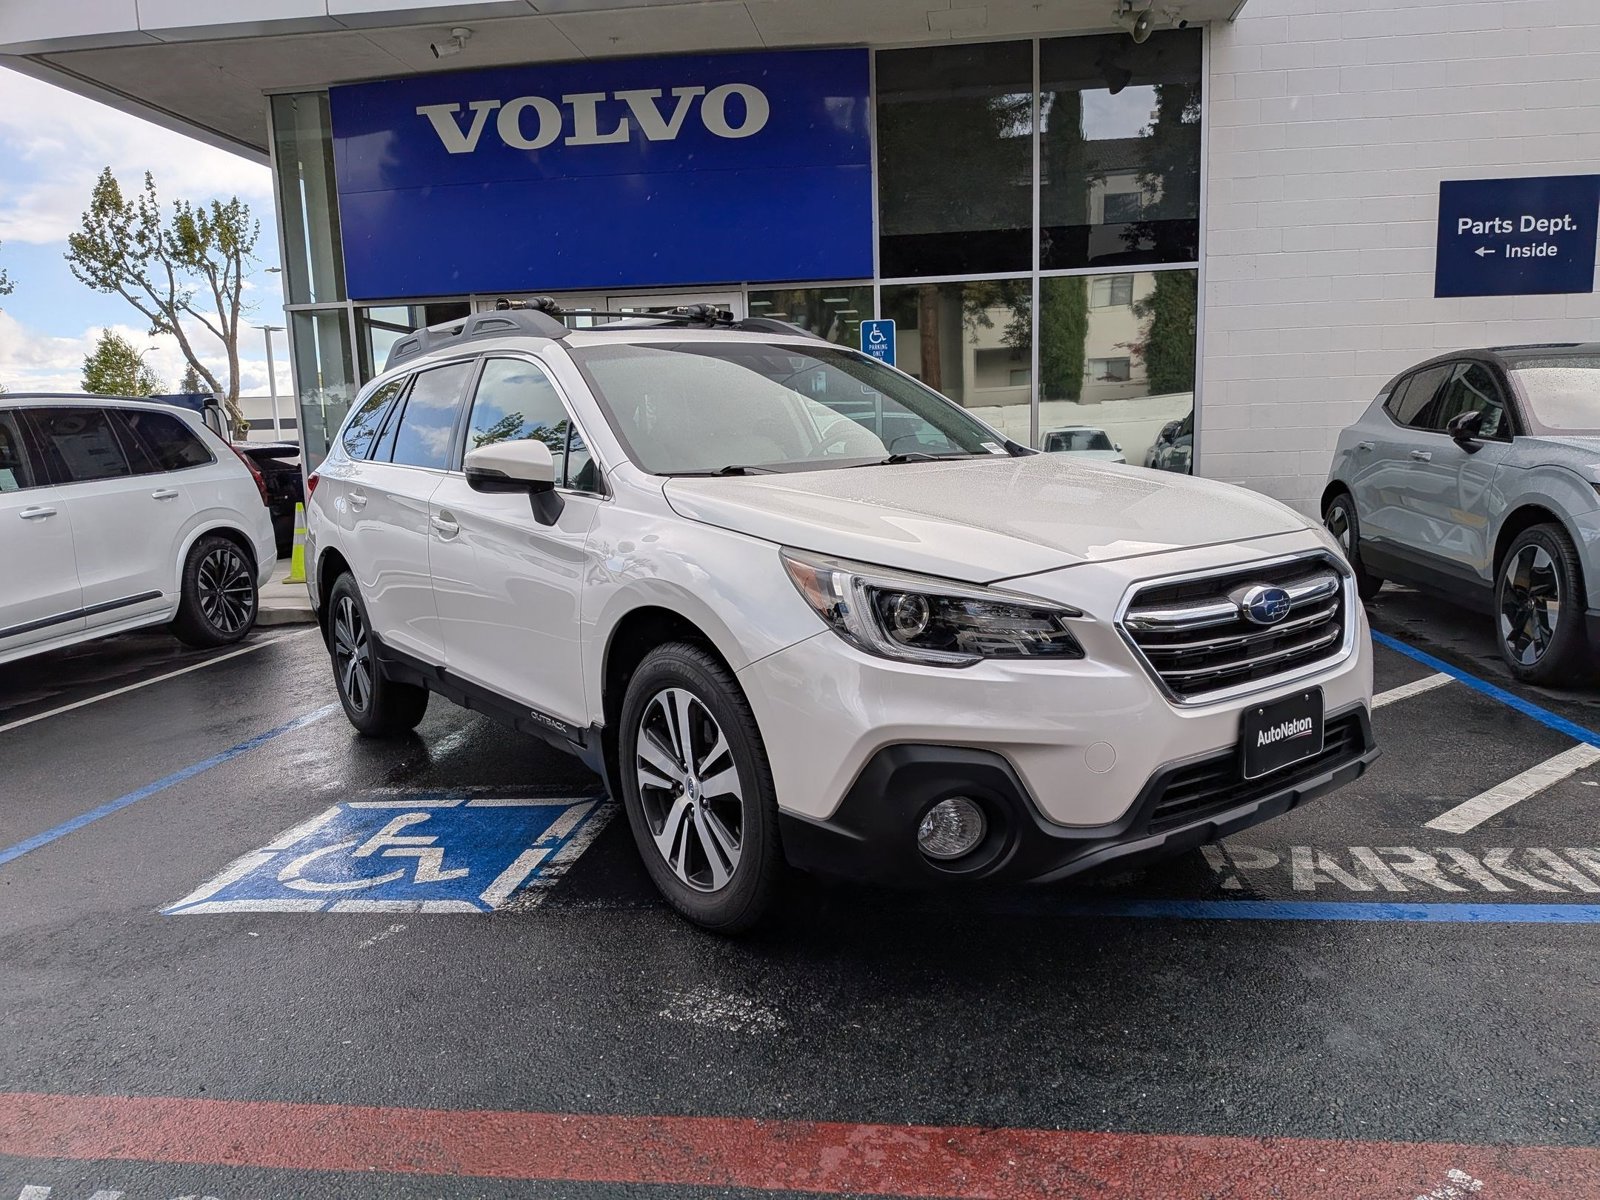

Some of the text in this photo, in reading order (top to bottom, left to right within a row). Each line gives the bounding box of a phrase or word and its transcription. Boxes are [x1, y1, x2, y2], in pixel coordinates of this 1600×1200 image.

[415, 83, 770, 154] VOLVO
[1457, 214, 1577, 235] Parts Dept.
[1505, 242, 1558, 258] Inside
[868, 343, 888, 351] PARKING
[530, 711, 567, 733] OUTBACK
[1257, 716, 1312, 748] AutoNation
